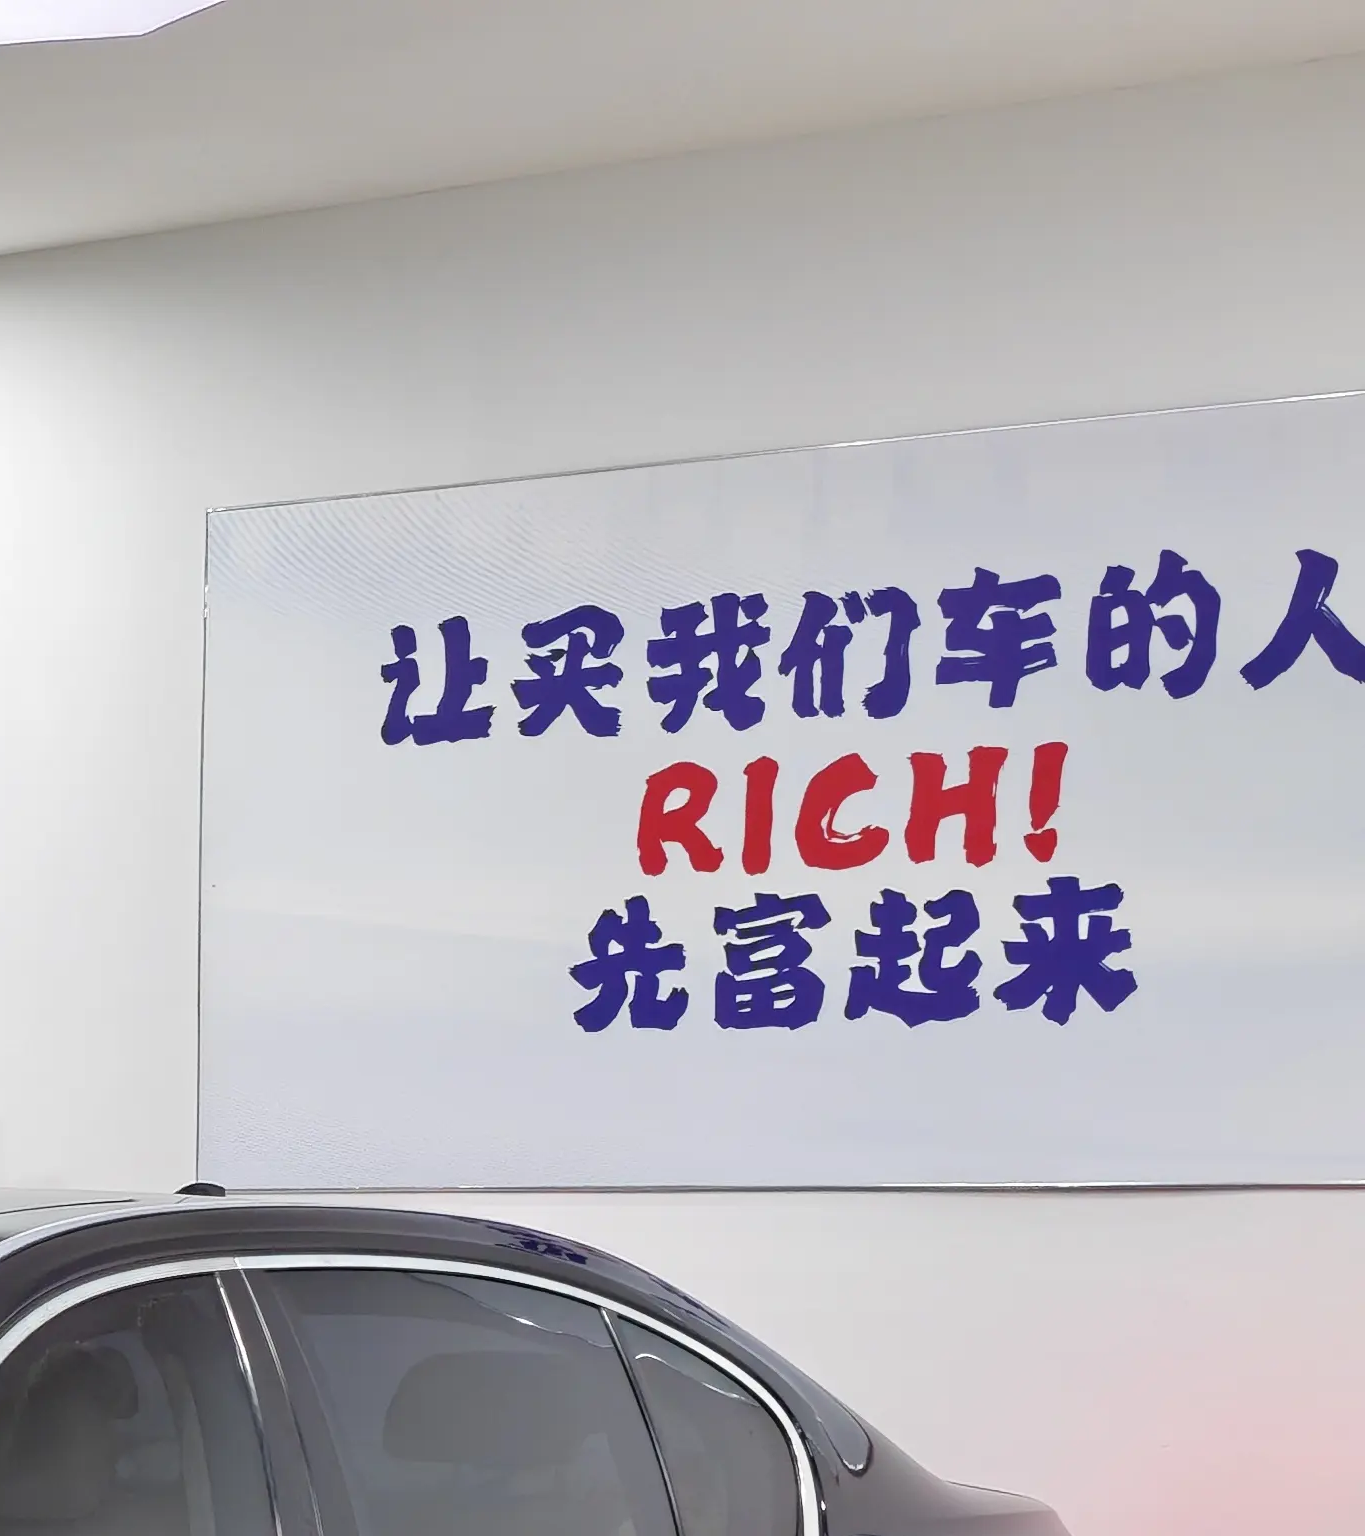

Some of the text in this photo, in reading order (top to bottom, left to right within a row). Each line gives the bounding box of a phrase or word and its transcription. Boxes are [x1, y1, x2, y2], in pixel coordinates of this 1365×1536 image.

[380, 549, 1365, 745] 让买我们车的人
[636, 742, 1070, 875] RICH!
[570, 877, 1138, 1032] 先富起来
